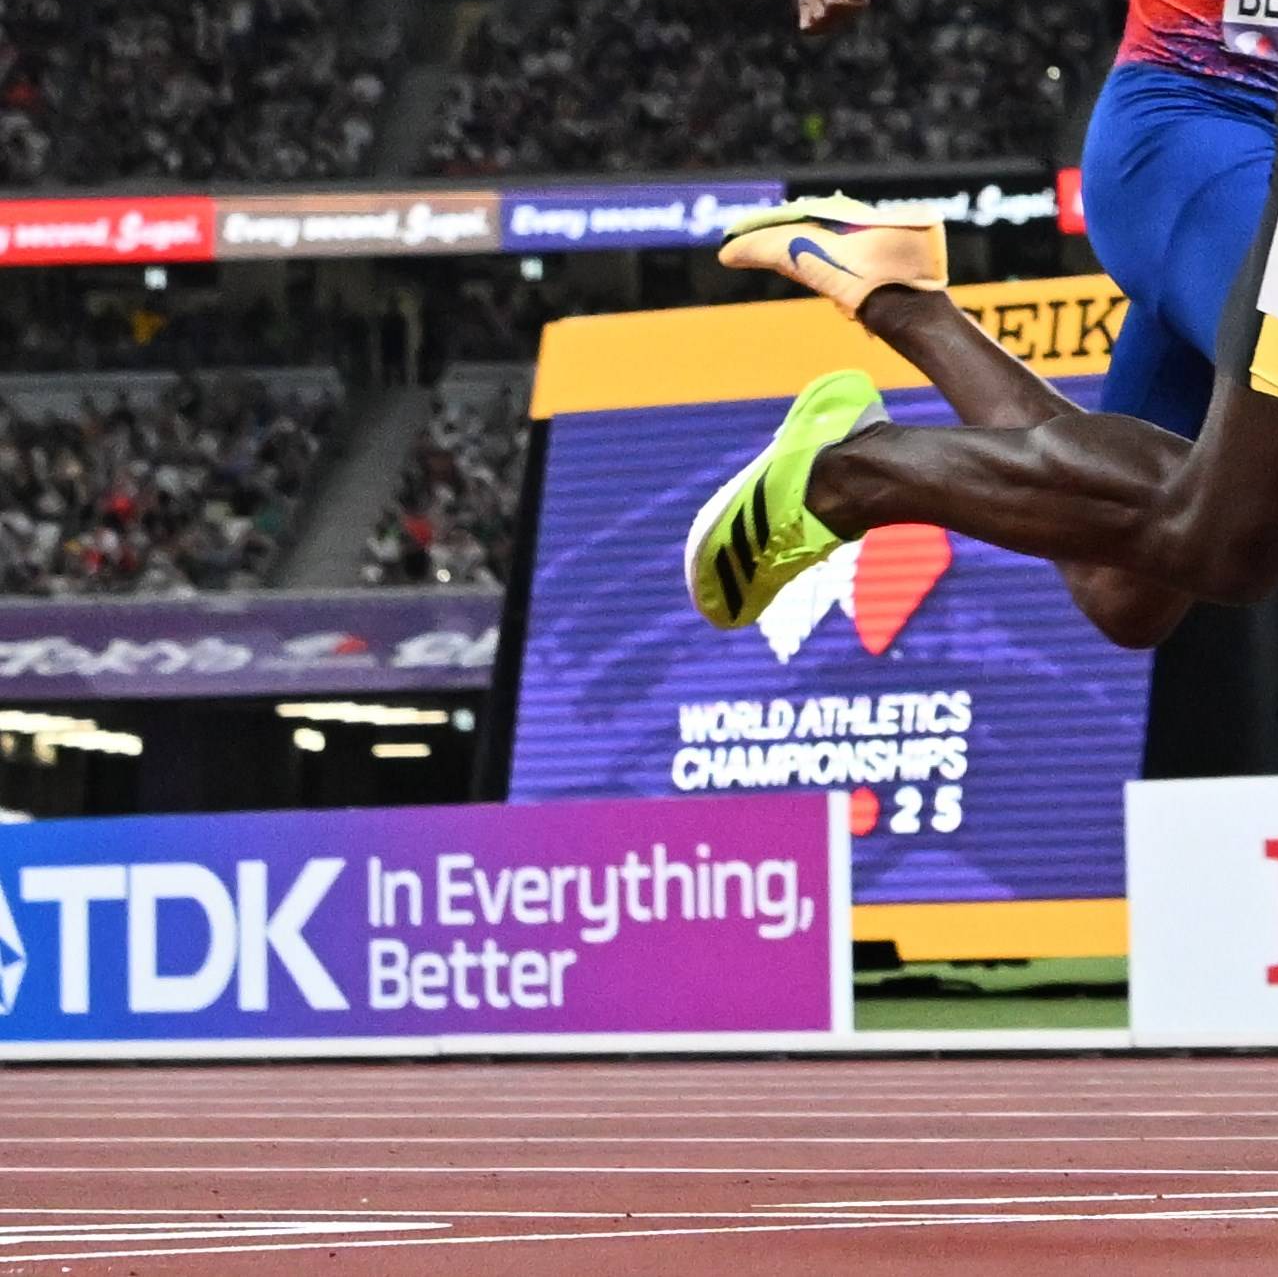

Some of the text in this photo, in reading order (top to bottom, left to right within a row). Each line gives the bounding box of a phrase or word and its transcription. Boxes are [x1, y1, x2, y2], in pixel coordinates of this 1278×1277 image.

[679, 690, 973, 743] WORLD ATHLETICS
[672, 735, 968, 791] CHAMPIONSHIPS
[368, 843, 815, 944] In Everything,
[21, 858, 351, 1015] TDK
[369, 938, 577, 1011] Better
